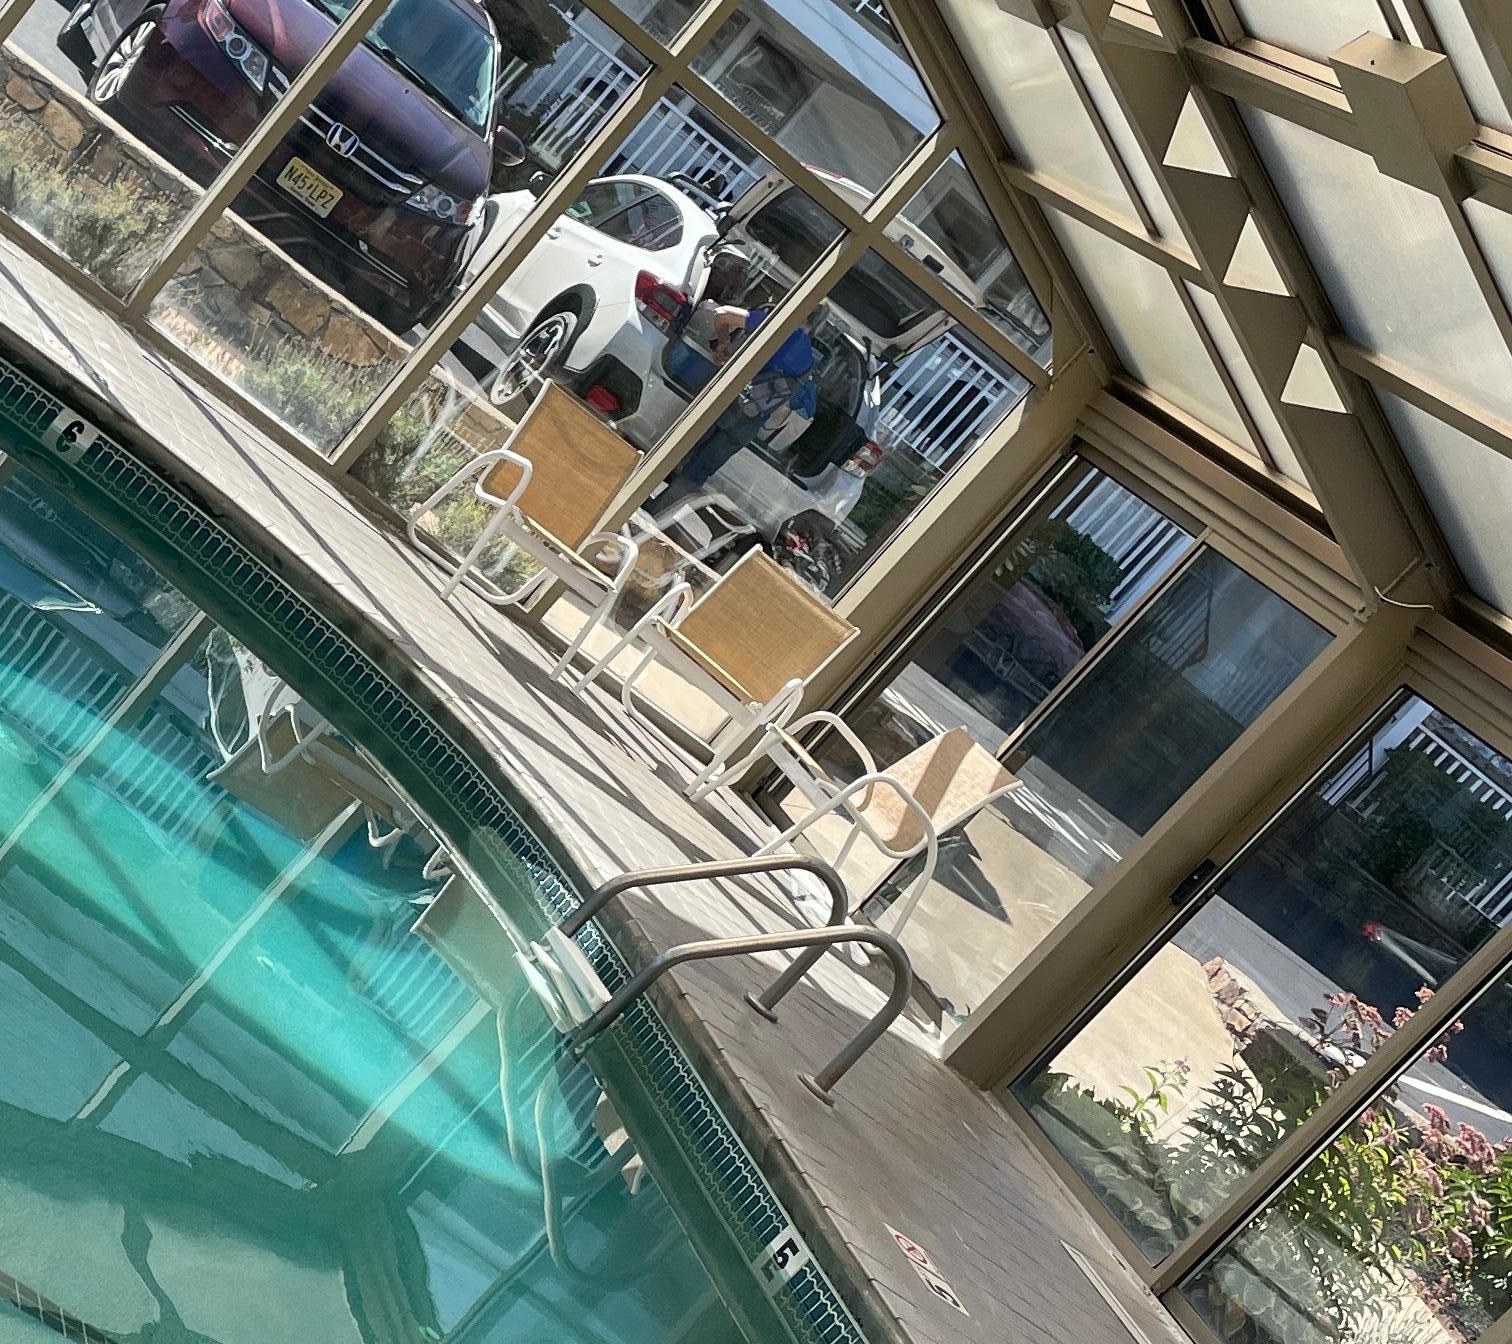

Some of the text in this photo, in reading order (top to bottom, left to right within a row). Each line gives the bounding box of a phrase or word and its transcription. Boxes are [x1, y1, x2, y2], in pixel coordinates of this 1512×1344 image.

[60, 419, 86, 447] 6
[772, 1237, 800, 1270] 5
[924, 1278, 961, 1308] 5
